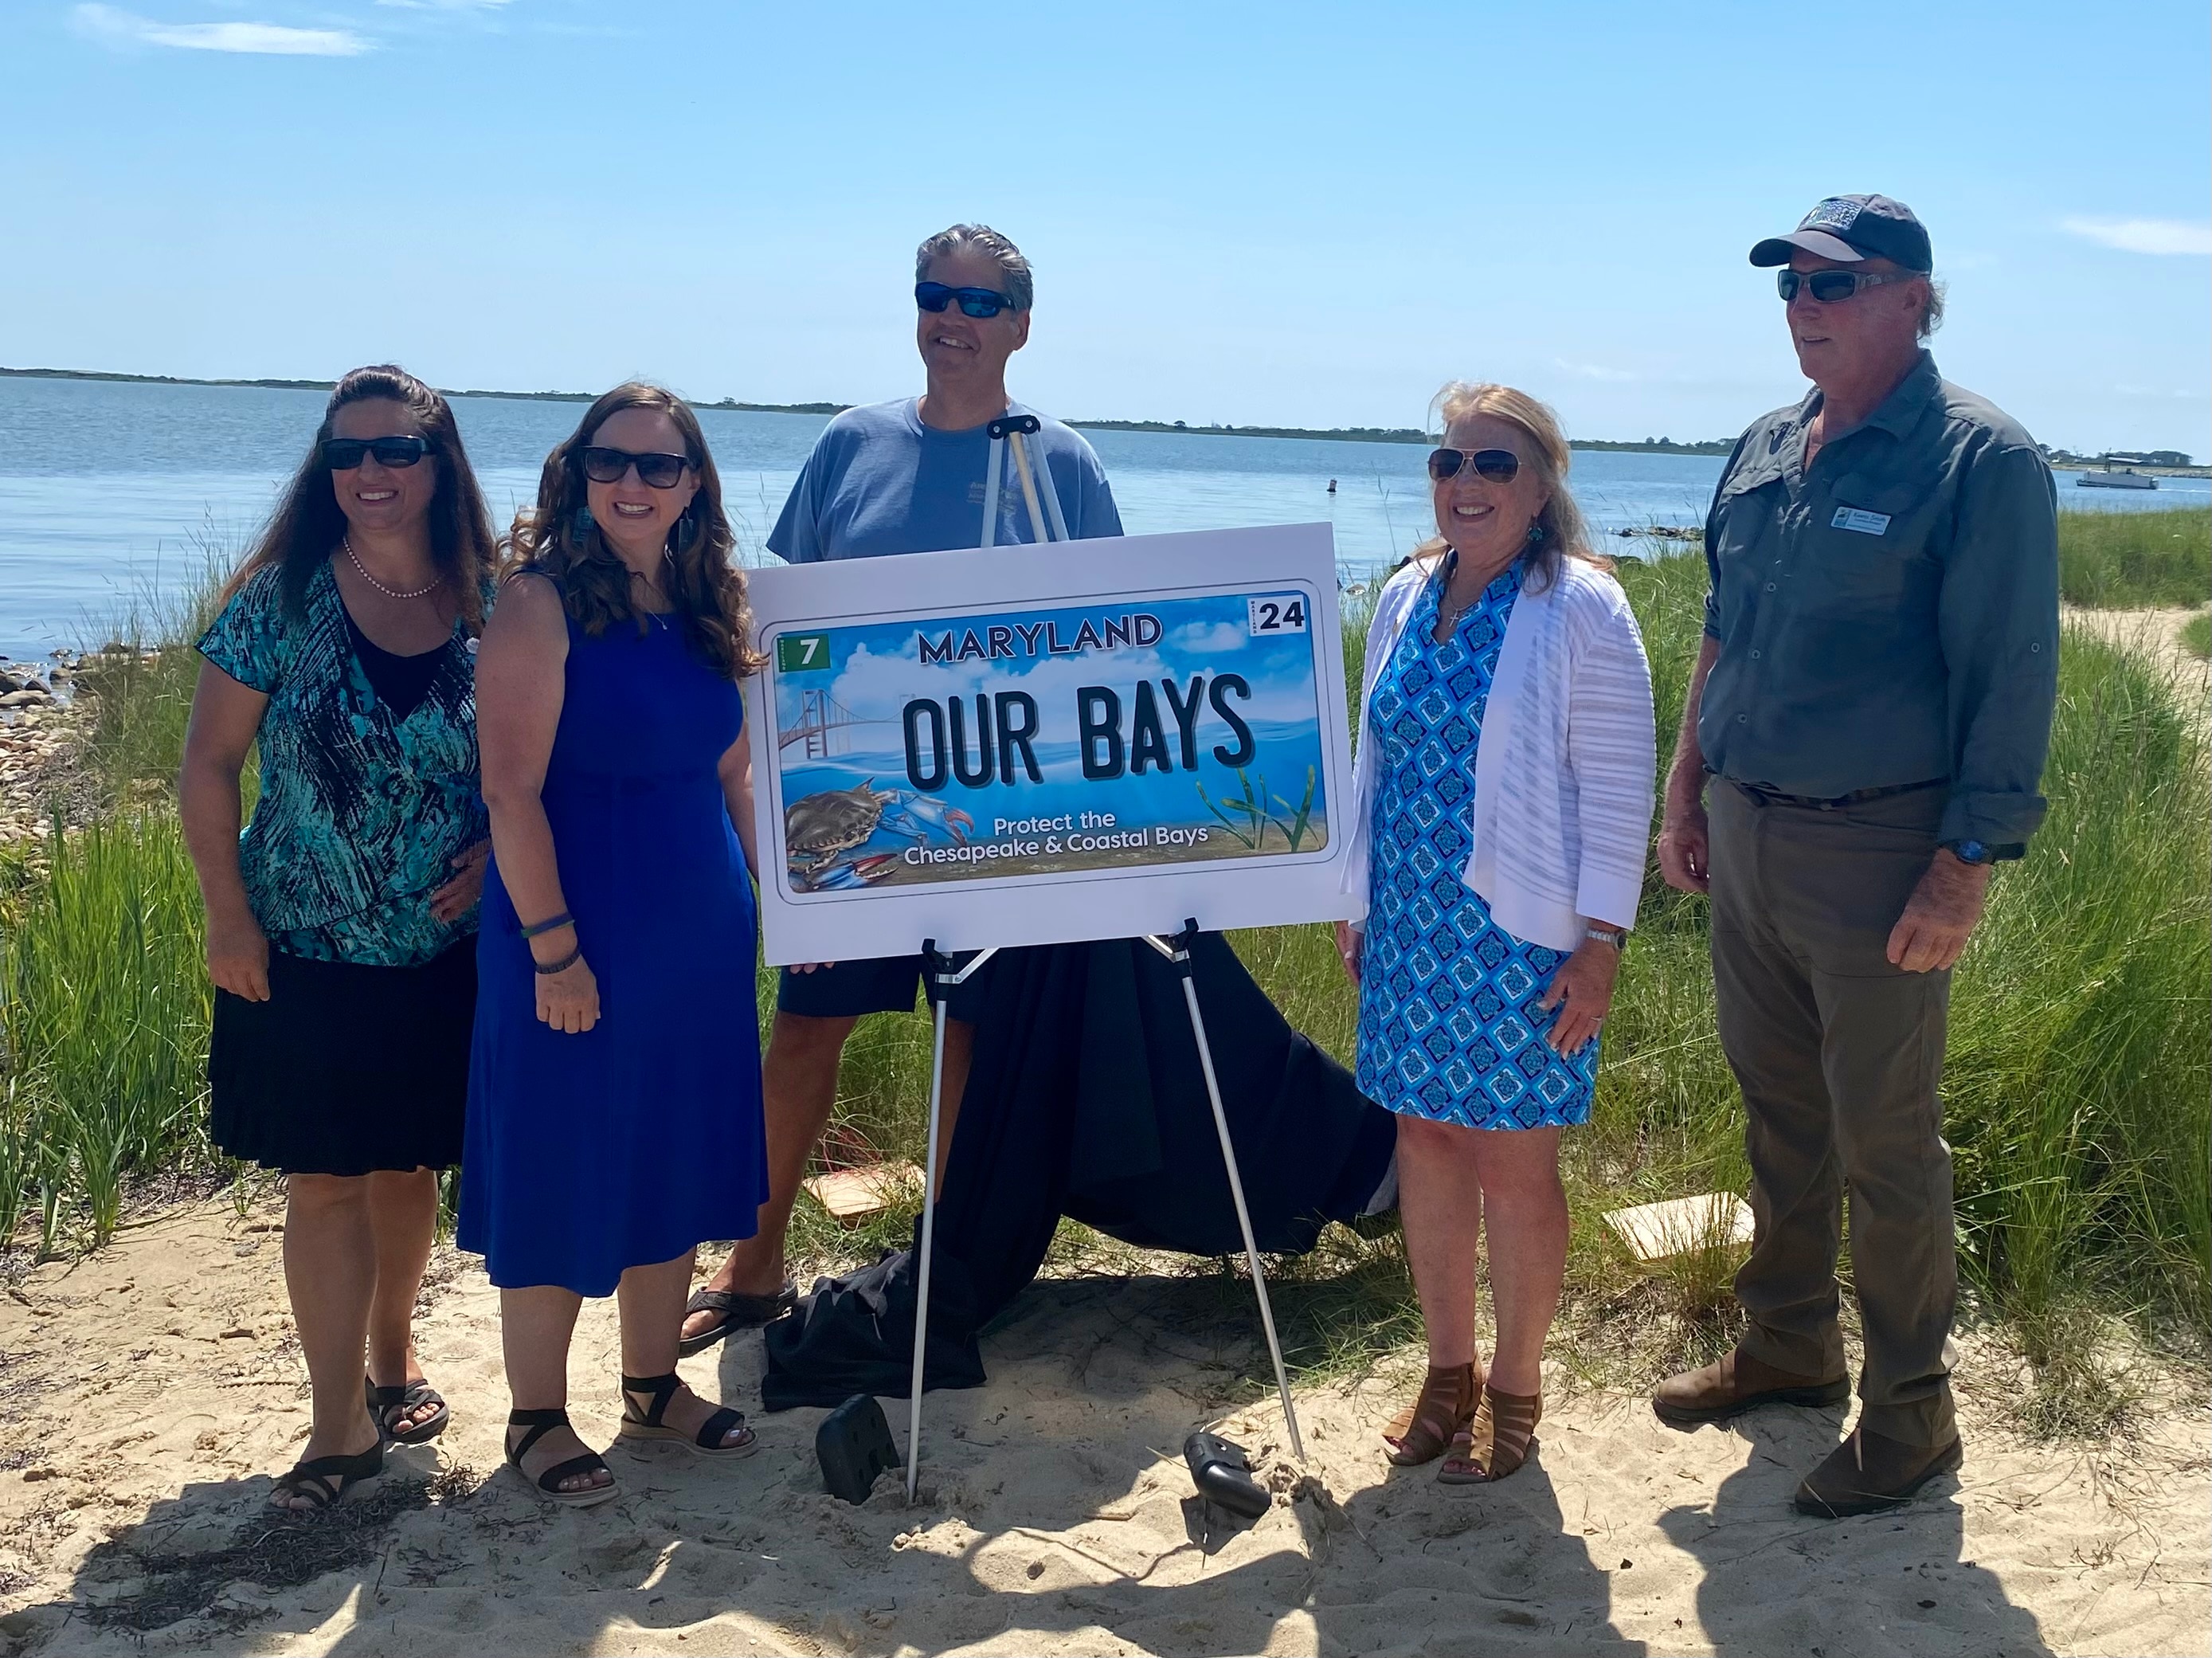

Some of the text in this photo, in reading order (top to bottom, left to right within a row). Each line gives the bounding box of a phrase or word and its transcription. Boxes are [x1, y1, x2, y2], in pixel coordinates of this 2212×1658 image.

[1259, 602, 1305, 629] 24
[800, 638, 820, 664] 7
[918, 613, 1163, 664] MARYLAND
[902, 672, 1256, 791] OUR BAYS
[993, 810, 1116, 837] Protect the
[904, 825, 1209, 866] Chesapeake & Coastal Bays
